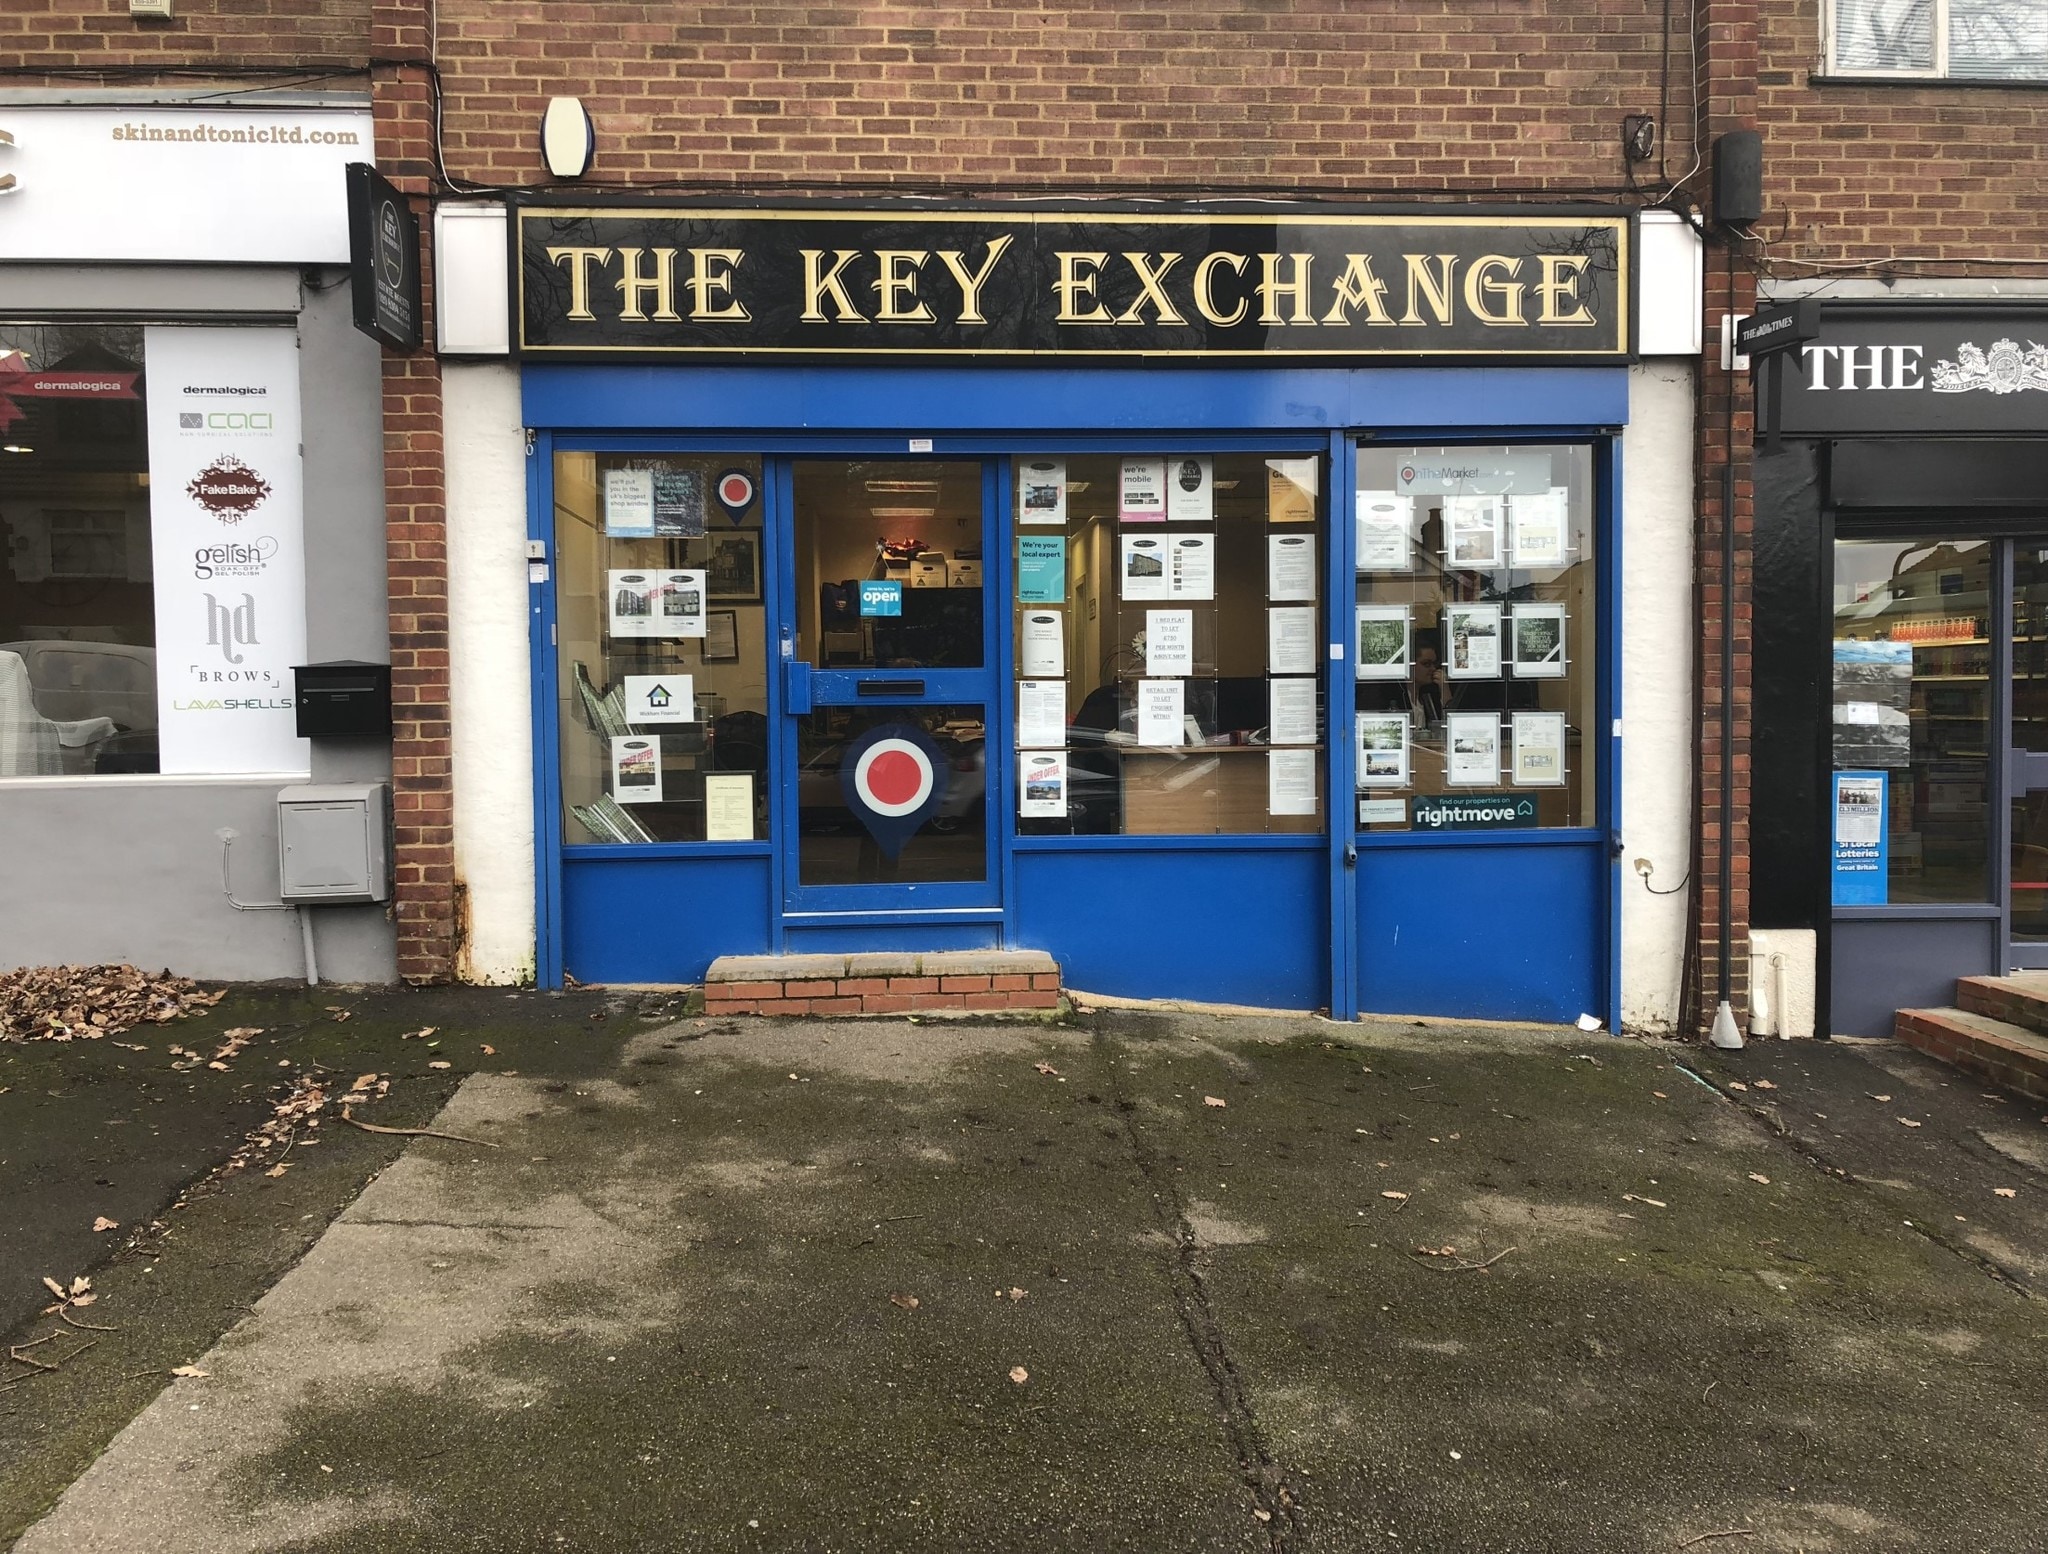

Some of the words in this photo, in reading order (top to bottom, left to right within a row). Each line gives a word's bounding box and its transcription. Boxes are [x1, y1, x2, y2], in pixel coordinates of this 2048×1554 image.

[112, 123, 359, 145] skinandtonicltd.com
[384, 219, 397, 240] KEY
[546, 247, 752, 322] THE
[799, 233, 1013, 325] KEY
[1050, 251, 1598, 327] EXCHANGE
[1743, 327, 1757, 341] THE
[1771, 315, 1793, 331] TIMES
[1802, 345, 1924, 390] THE
[34, 381, 121, 391] dermalogica
[183, 386, 267, 396] dermalogica
[1124, 475, 1152, 483] mobile
[200, 484, 228, 495] Fake
[228, 484, 257, 495] Bake
[1042, 543, 1059, 551] your
[194, 541, 265, 580] gelish
[1022, 550, 1037, 558] local
[1038, 551, 1061, 559] expert
[863, 591, 899, 605] open
[203, 592, 260, 664] hd
[199, 671, 271, 682] BROWS
[1043, 764, 1060, 778] OFFER
[1465, 797, 1500, 805] properties
[1416, 806, 1515, 827] rightmove
[1836, 849, 1880, 858] Lotteries
